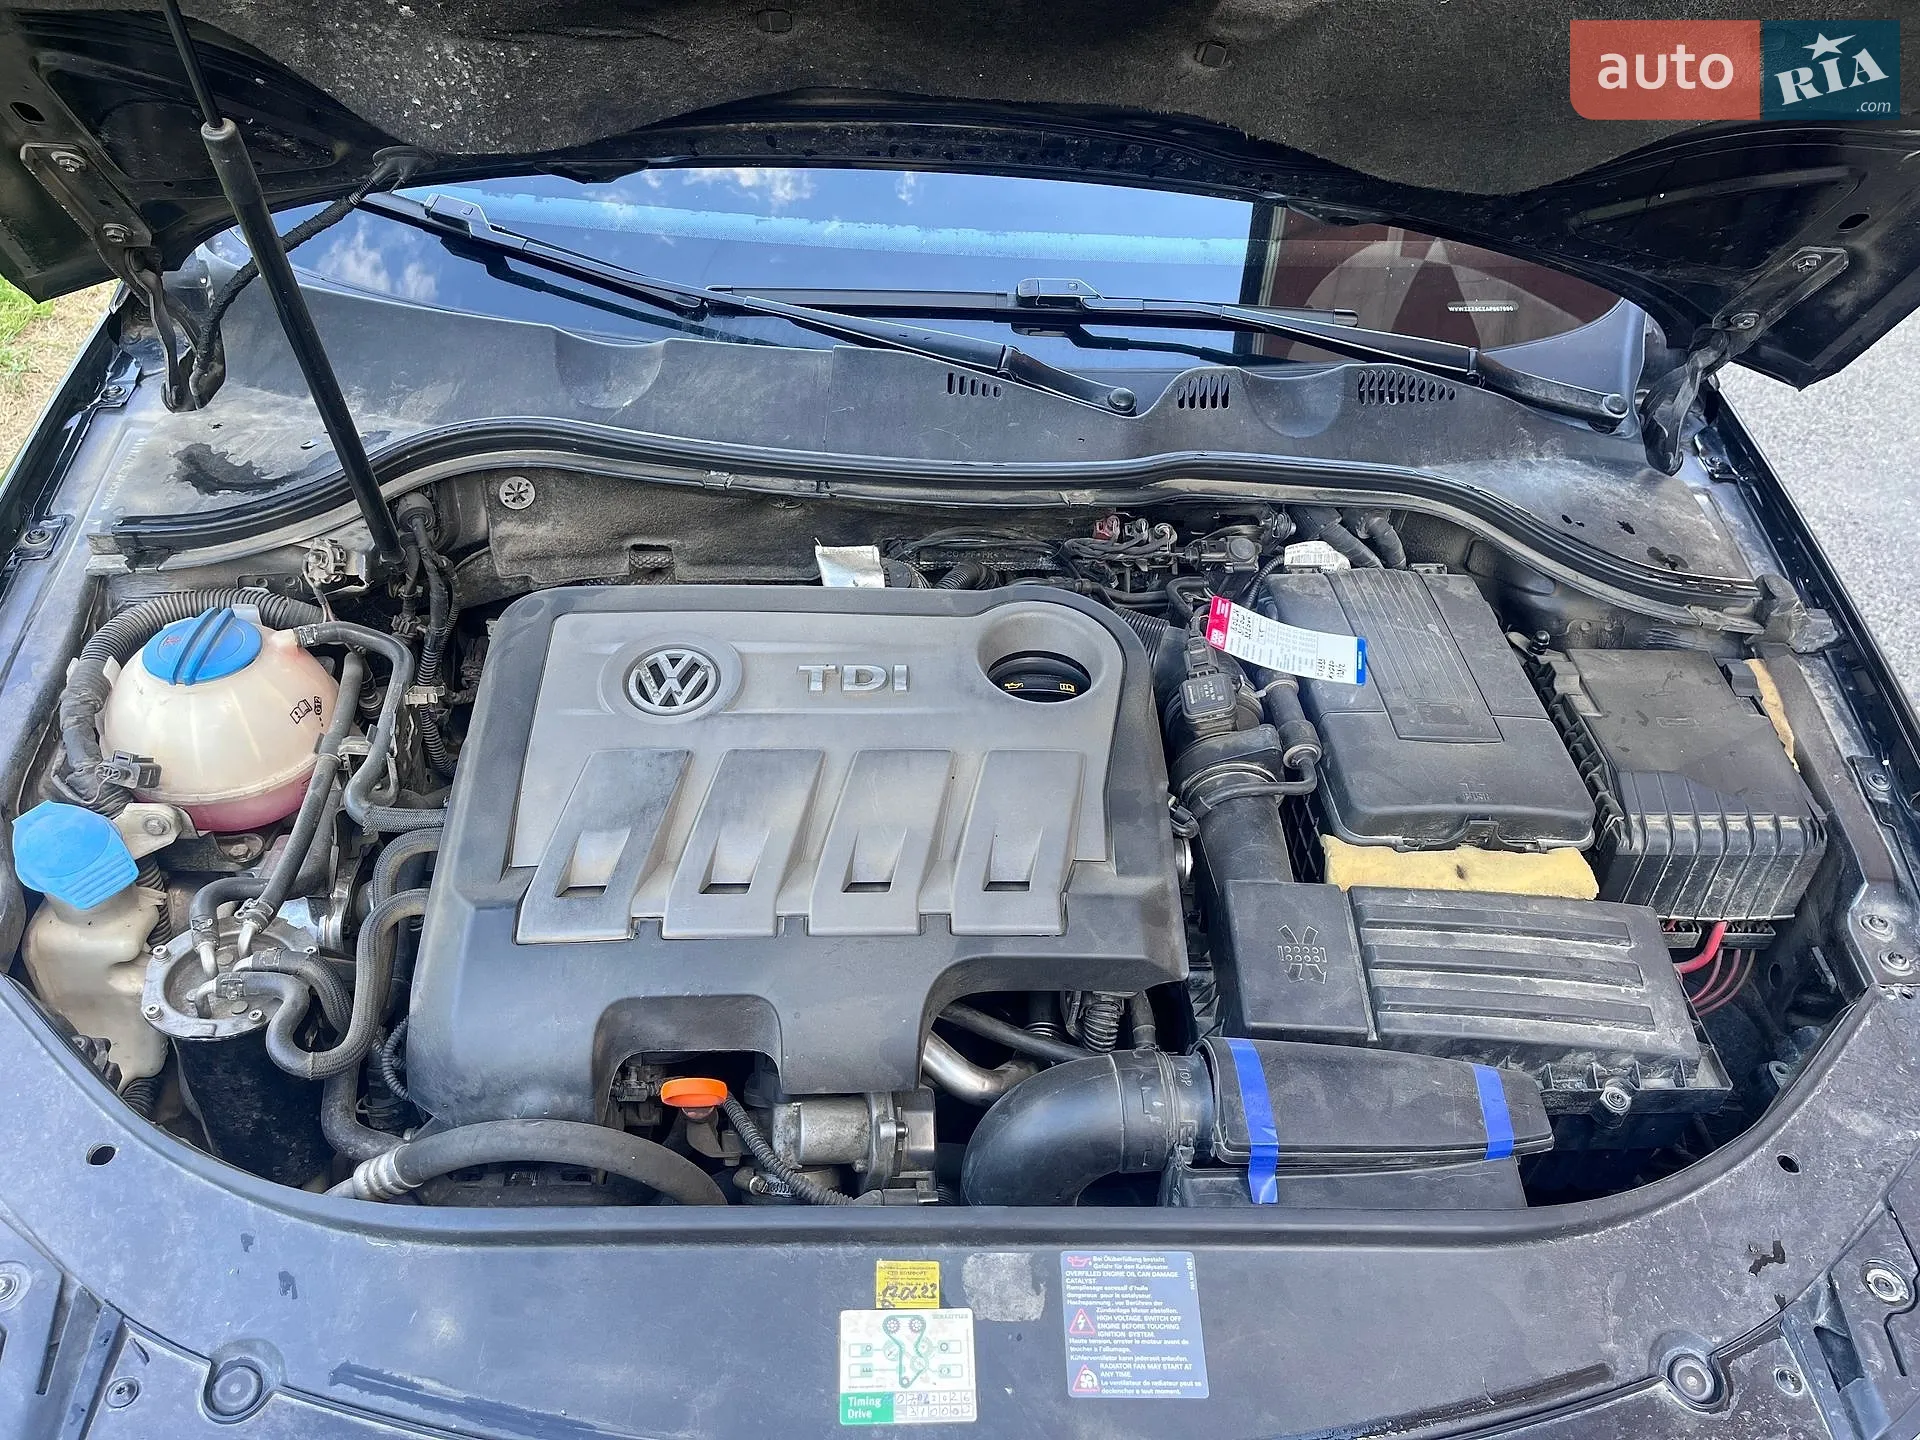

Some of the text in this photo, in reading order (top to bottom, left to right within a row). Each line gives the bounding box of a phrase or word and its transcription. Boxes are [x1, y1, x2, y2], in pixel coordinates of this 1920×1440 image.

[798, 664, 910, 692] TDI
[847, 1396, 882, 1408] Timing
[847, 1409, 873, 1419] Drive
